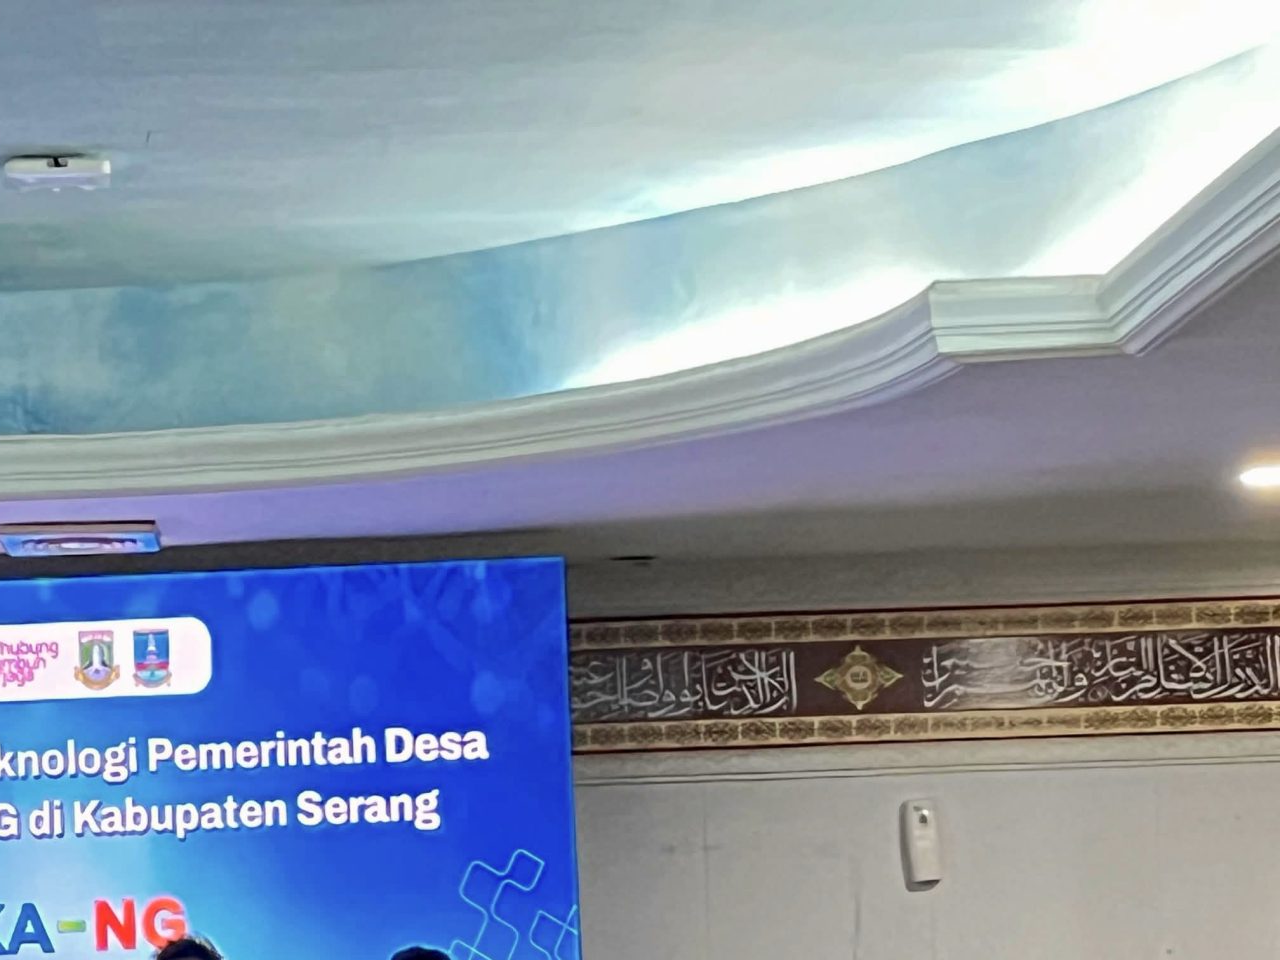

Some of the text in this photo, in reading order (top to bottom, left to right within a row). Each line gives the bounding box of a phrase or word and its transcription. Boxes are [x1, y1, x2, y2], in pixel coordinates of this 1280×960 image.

[147, 727, 377, 773] Pemerintah
[385, 727, 490, 763] Desa
[28, 799, 64, 838] di
[73, 794, 288, 841] Kabupaten
[296, 788, 442, 831] Serang
